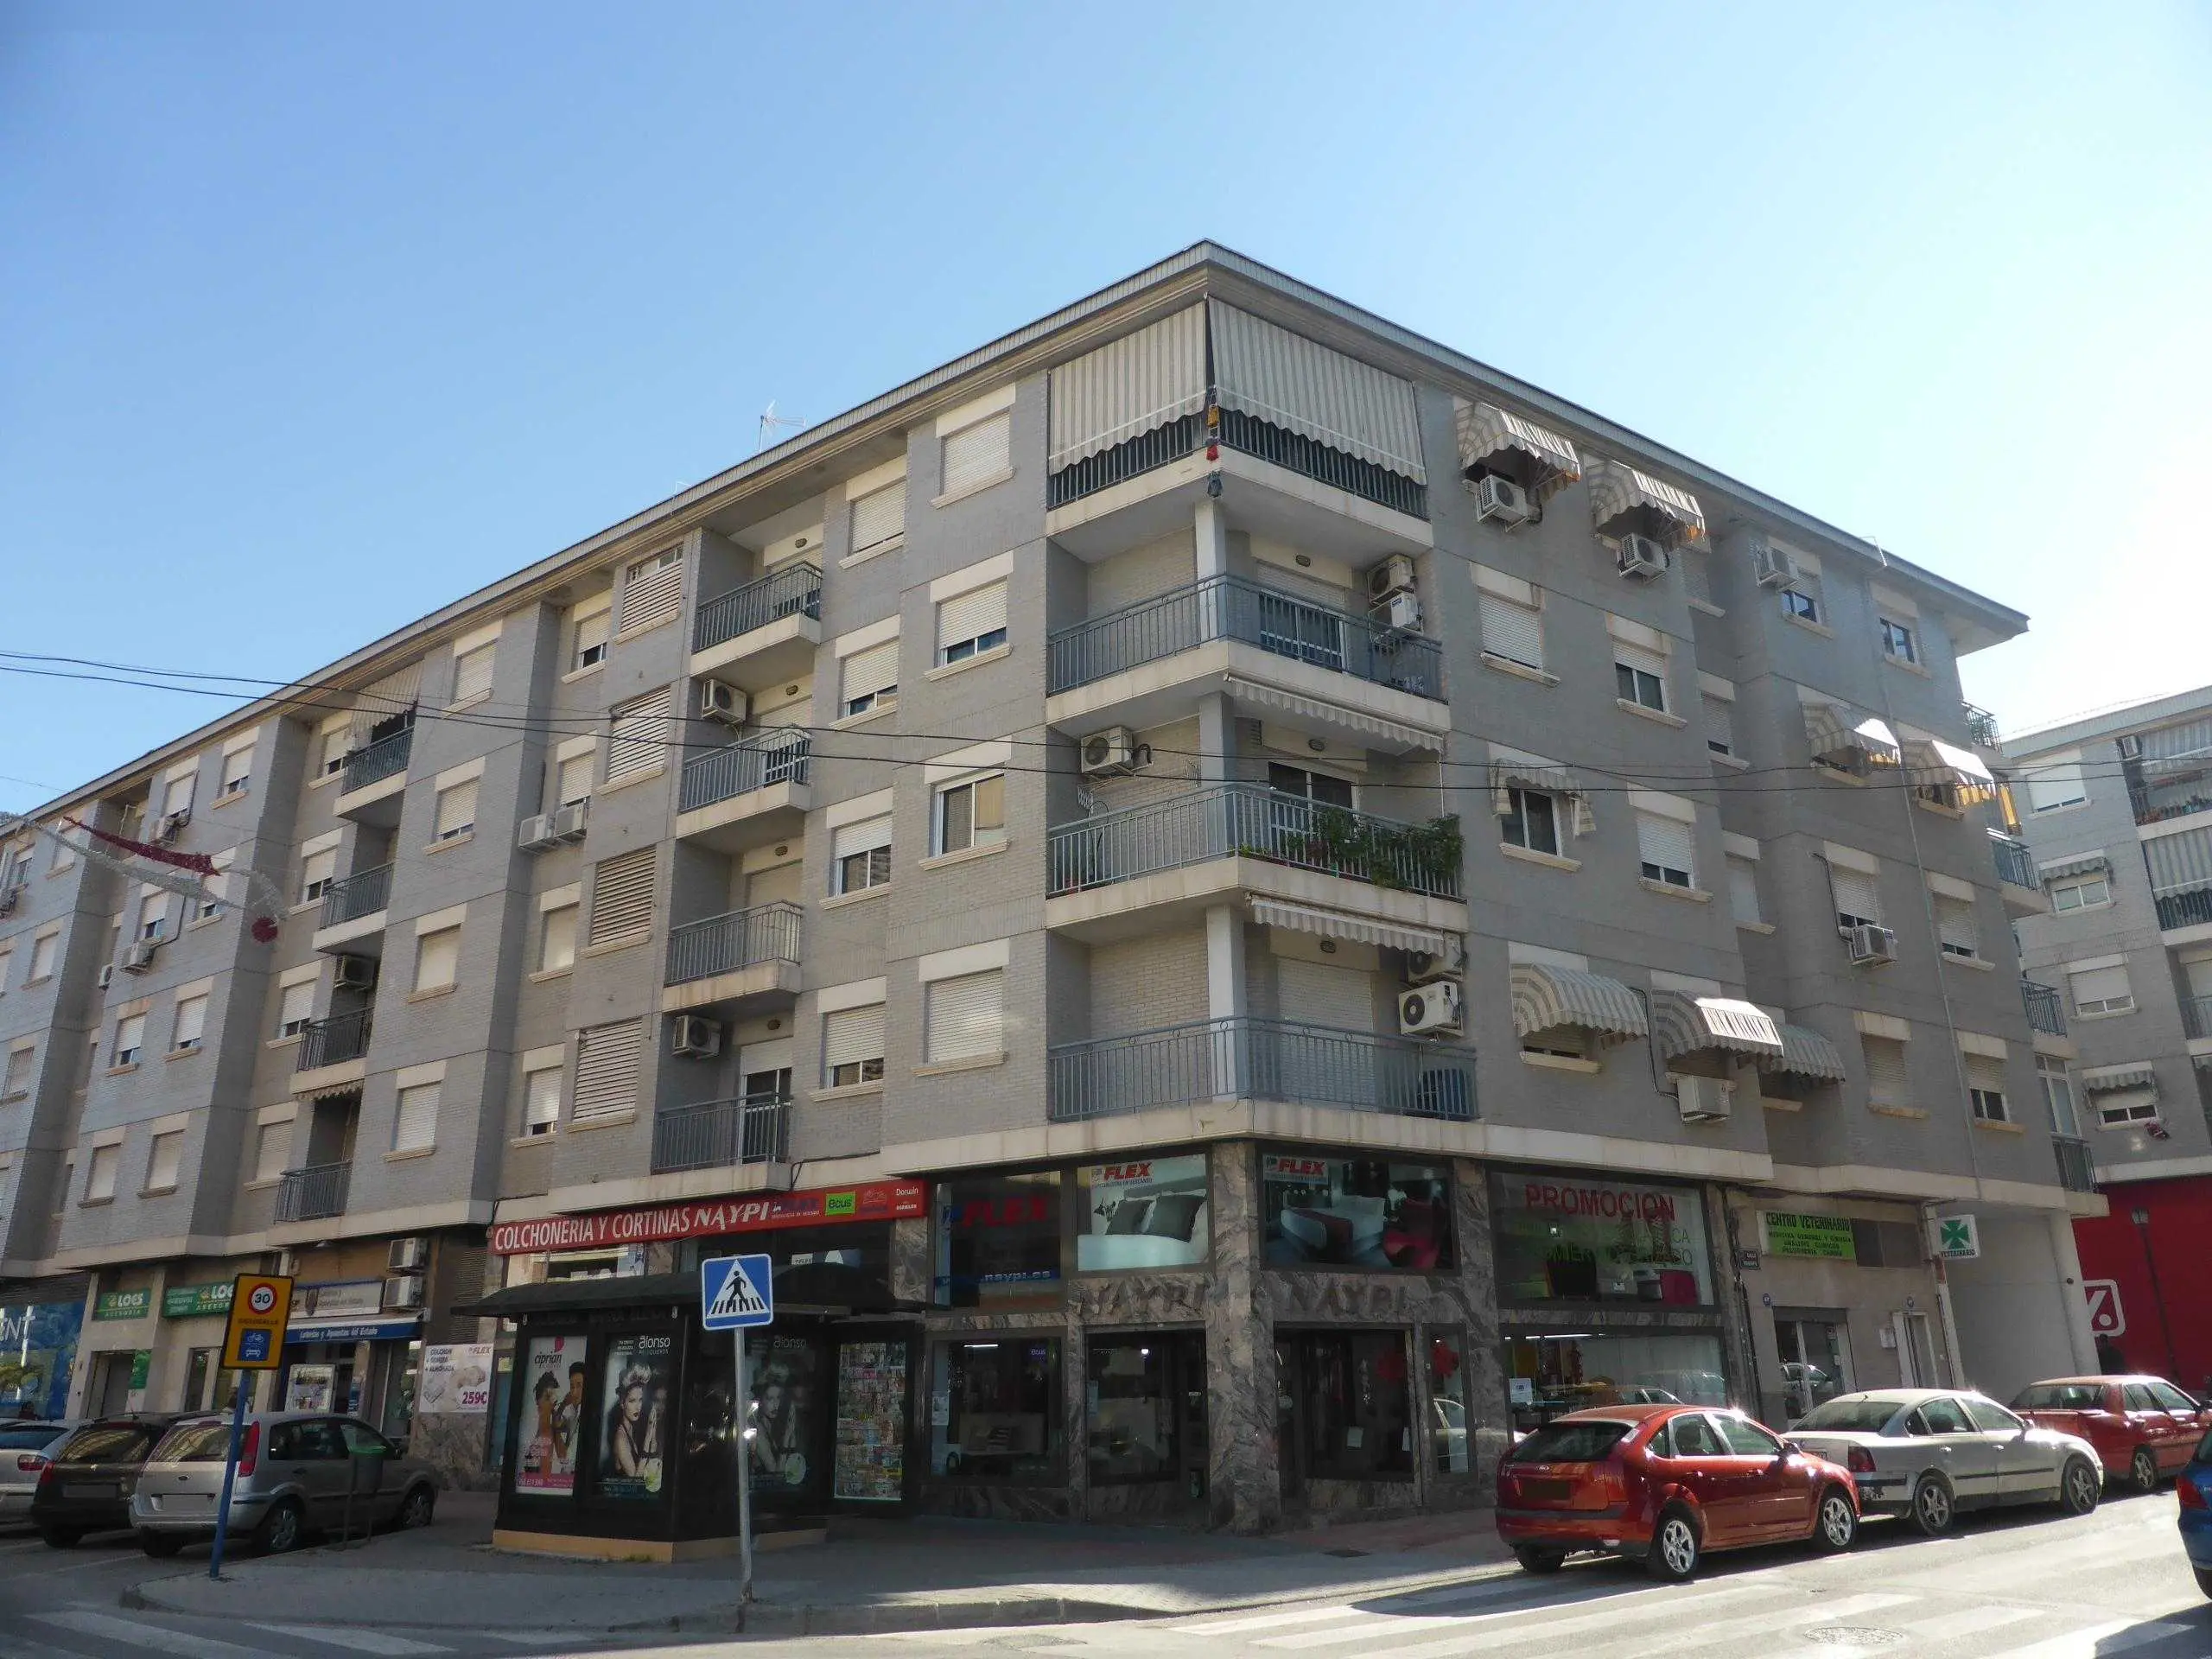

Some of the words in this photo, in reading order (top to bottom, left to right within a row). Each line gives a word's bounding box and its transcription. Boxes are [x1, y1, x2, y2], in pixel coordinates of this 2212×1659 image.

[1104, 1162, 1152, 1181] FLEX
[1280, 1159, 1325, 1175] FLEX
[1525, 1184, 1675, 1223] PROMOCION
[495, 1217, 594, 1250] COLCHONERIA
[598, 1216, 609, 1240] Y
[612, 1207, 690, 1238] CORTINAS
[694, 1201, 770, 1230] NAYPI
[1766, 1211, 1796, 1227] CENTRO
[1799, 1214, 1851, 1231] VETERINARIO
[196, 1301, 230, 1311] ASESOR
[255, 1294, 270, 1303] 30
